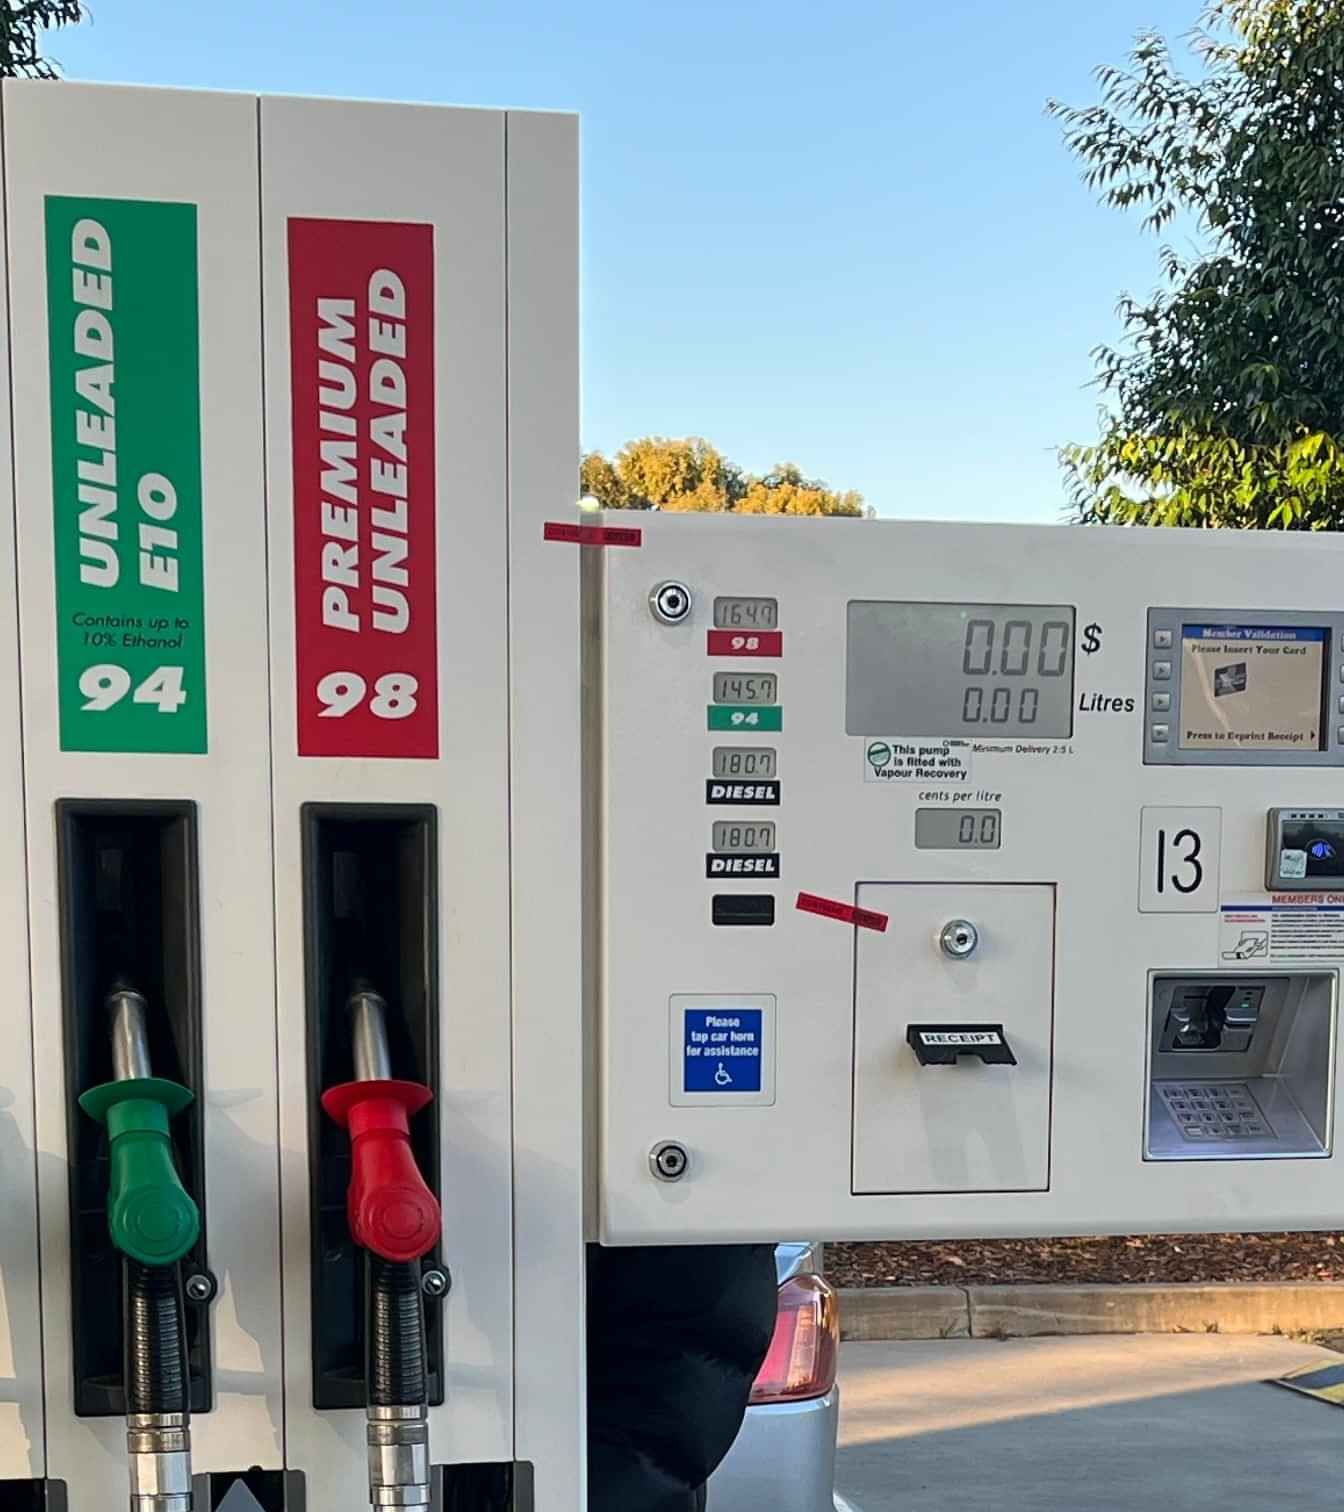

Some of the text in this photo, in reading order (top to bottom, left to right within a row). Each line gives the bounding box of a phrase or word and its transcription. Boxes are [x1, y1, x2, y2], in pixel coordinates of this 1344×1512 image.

[72, 219, 119, 588] UNLEADED
[369, 268, 409, 634] UNLEADED
[317, 298, 360, 633] PREMIUM
[137, 472, 179, 592] E10
[72, 612, 190, 632] Contains up to
[83, 632, 183, 648] 10% Ethanol
[1081, 623, 1103, 655] $
[1245, 629, 1296, 640] Validation
[731, 637, 759, 650] 98
[962, 619, 1069, 676] 0.00
[78, 663, 187, 713] 94
[316, 672, 419, 719] 98
[1079, 693, 1135, 712] Litres
[962, 687, 1039, 723] 0.00
[731, 712, 759, 725] 94
[892, 745, 950, 757] This pump
[894, 757, 961, 767] is fitted with
[874, 768, 967, 780] Vapour Recovery
[711, 786, 775, 800] DIESEL
[918, 790, 1002, 803] cents per litre
[711, 859, 775, 873] DIESEL
[1157, 829, 1202, 893] 13
[1272, 894, 1324, 904] MEMBERS
[706, 1016, 740, 1027] Please
[691, 1030, 754, 1043] tap car horn
[924, 1033, 996, 1043] RECEIPT
[686, 1045, 759, 1056] for assistance
